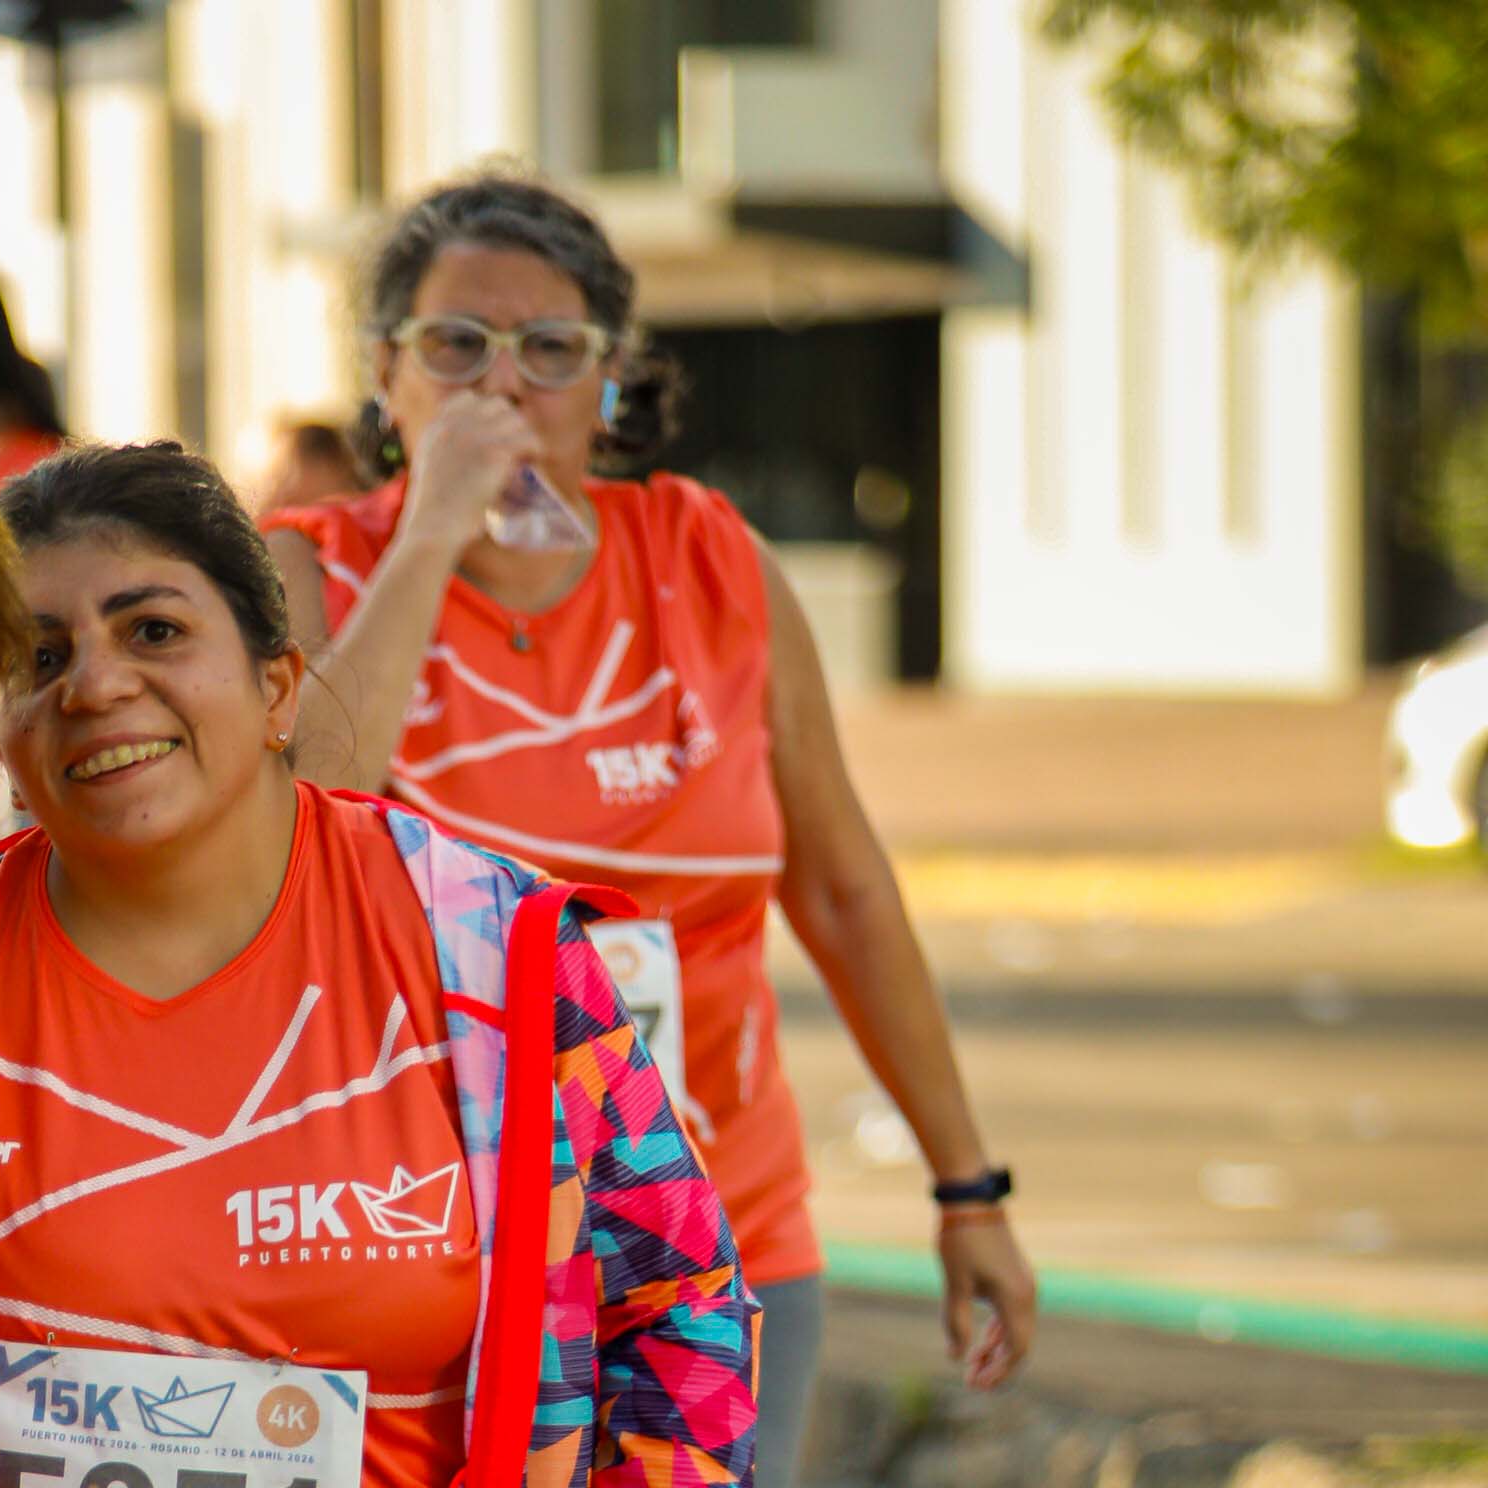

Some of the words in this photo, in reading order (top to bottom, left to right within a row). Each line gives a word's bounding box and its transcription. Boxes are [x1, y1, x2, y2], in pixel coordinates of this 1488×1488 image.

[585, 743, 677, 789] 15K
[225, 1182, 351, 1247] 15K
[239, 1246, 352, 1267] PUERTO
[366, 1241, 454, 1260] NORTE
[26, 1376, 124, 1431] 15K
[268, 1404, 308, 1431] 4K
[21, 1428, 66, 1441] PUERTO
[70, 1434, 106, 1448] NORTE
[150, 1443, 200, 1456] ROSARIO
[214, 1448, 227, 1457] 12
[231, 1448, 245, 1458] DE
[249, 1451, 283, 1461] ABRIL
